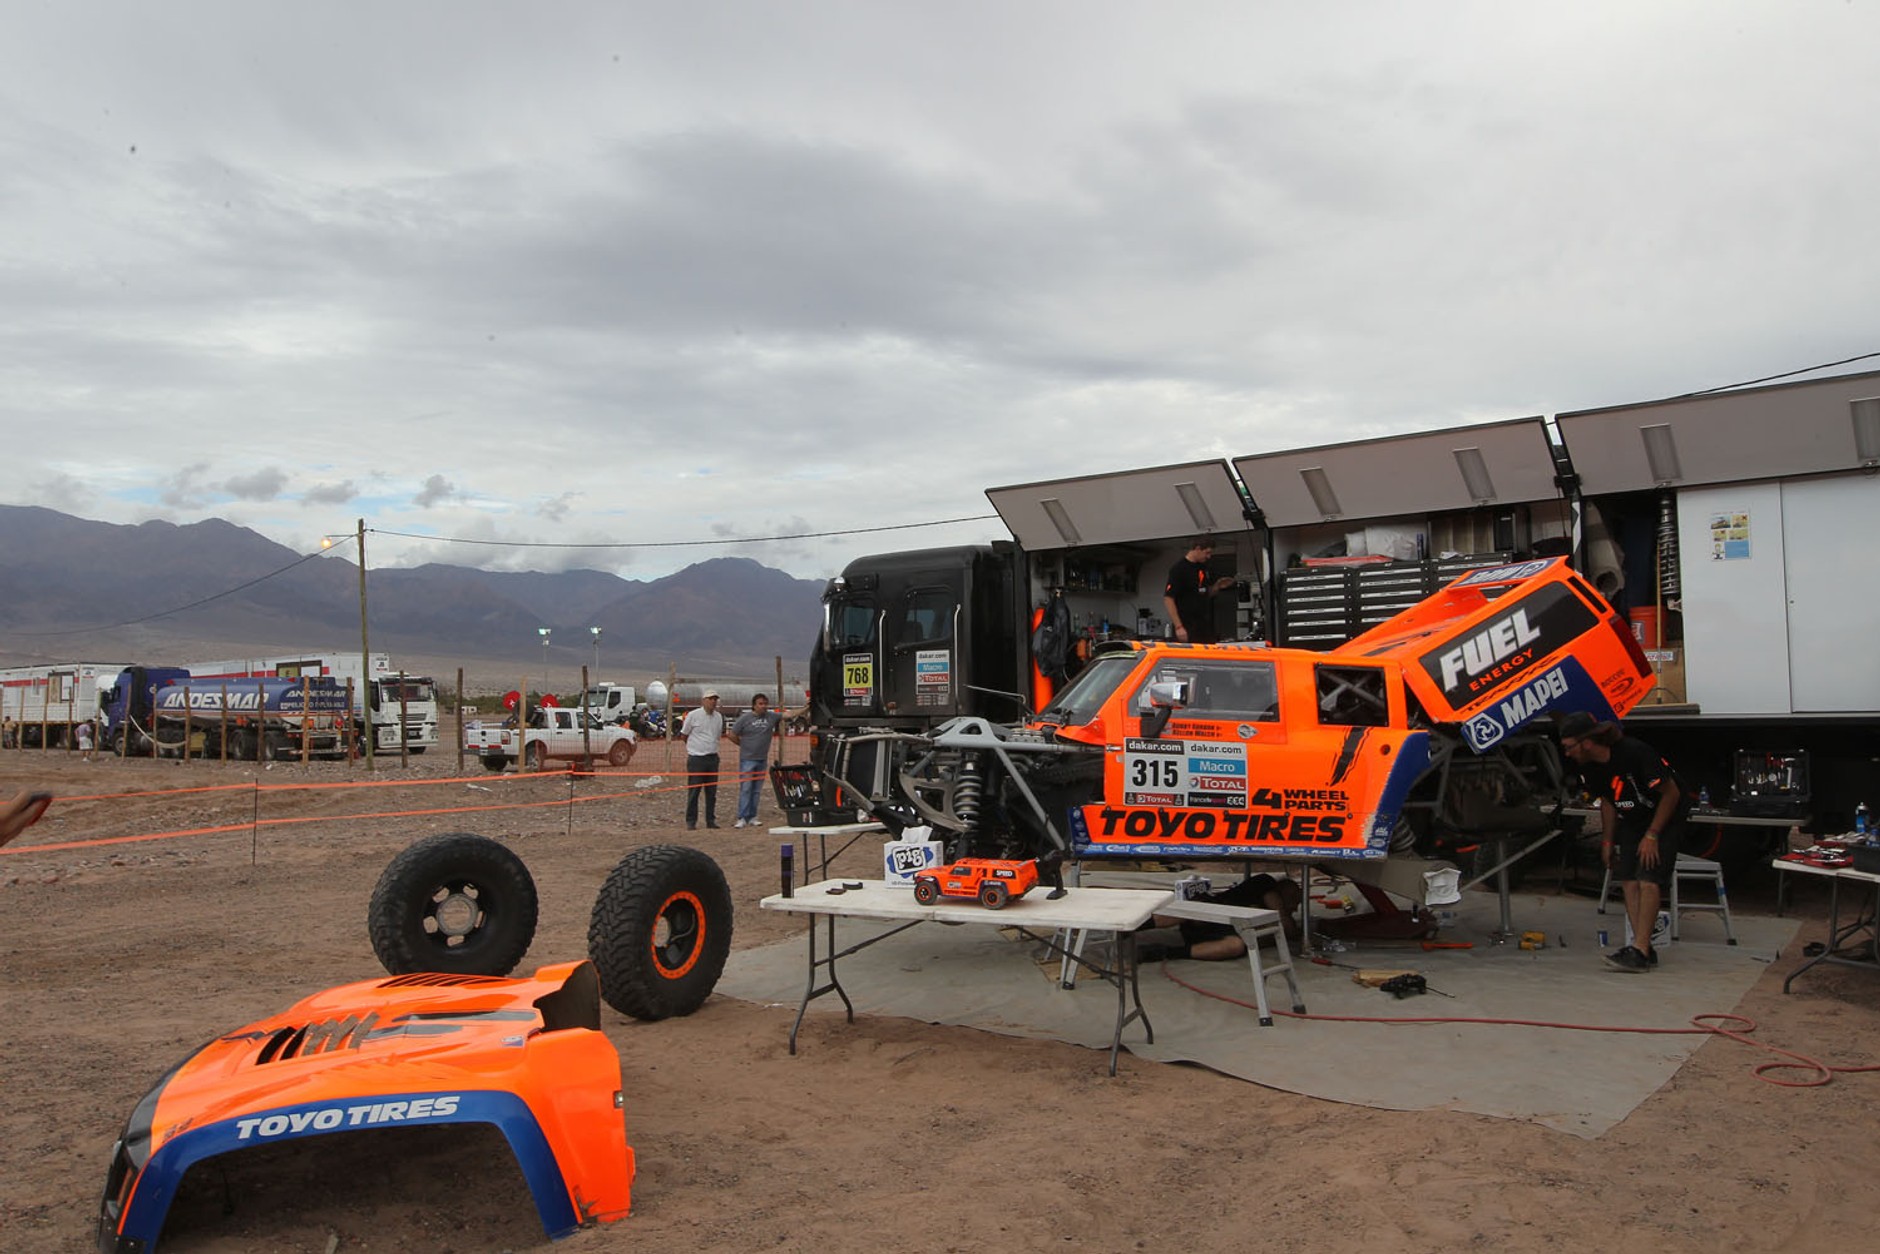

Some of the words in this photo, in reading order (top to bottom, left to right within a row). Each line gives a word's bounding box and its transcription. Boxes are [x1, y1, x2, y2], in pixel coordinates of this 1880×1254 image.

[1440, 608, 1540, 693] FUEL
[847, 667, 869, 684] 768
[1468, 648, 1533, 692] ENERGY
[286, 690, 346, 698] ANESMAR
[1500, 666, 1569, 729] MAPEI
[1129, 741, 1182, 752] dakar.com
[1190, 744, 1242, 754] dakar.com
[1132, 759, 1178, 787] 315
[1200, 761, 1235, 772] Macro
[1202, 778, 1245, 789] TOTAL
[1252, 788, 1282, 809] 4
[1284, 789, 1349, 800] WHEEL
[1285, 801, 1346, 811] PARTS
[1100, 809, 1216, 839] TOYO
[1224, 813, 1346, 842] TIRES
[236, 1108, 344, 1140] TOYO
[347, 1096, 461, 1125] TIRES
